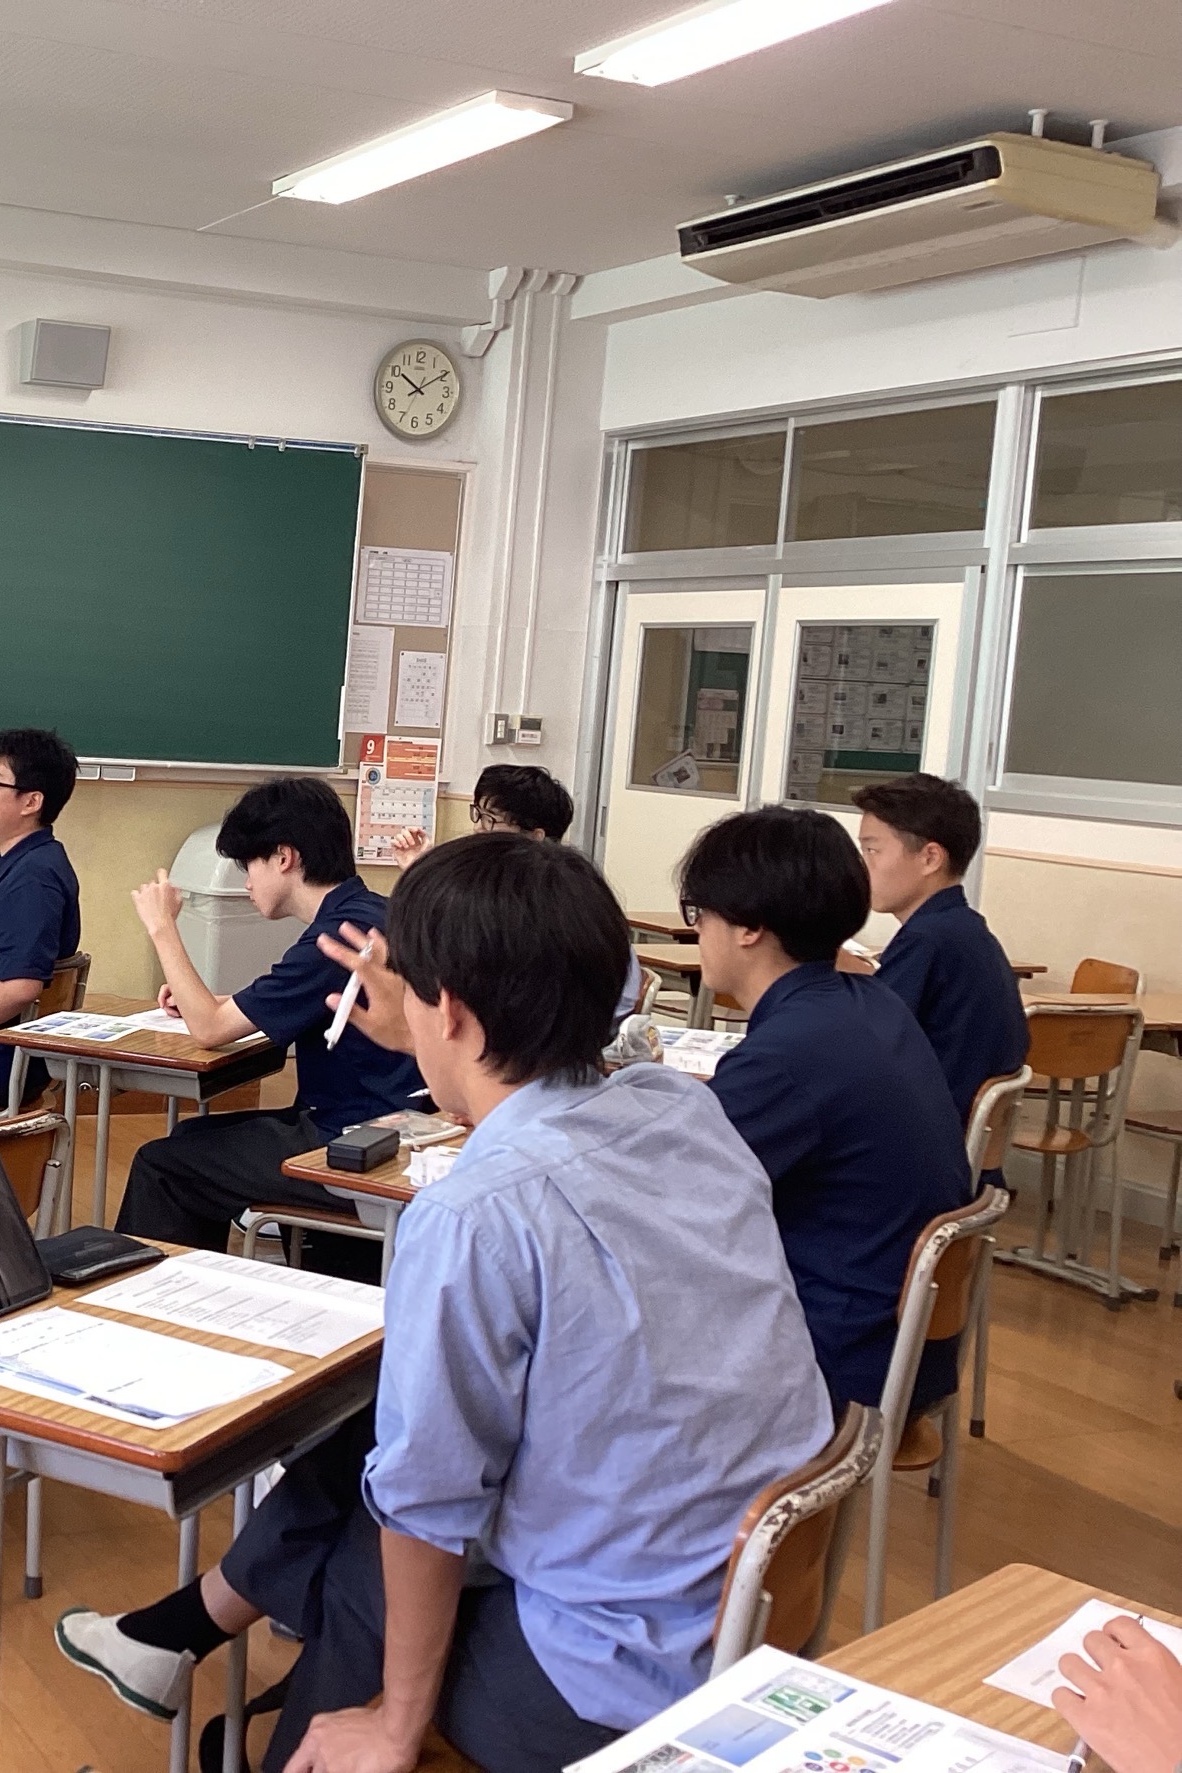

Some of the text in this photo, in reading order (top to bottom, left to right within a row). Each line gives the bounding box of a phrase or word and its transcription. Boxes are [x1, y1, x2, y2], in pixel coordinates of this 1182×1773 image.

[403, 354, 410, 365] 11
[416, 351, 426, 363] 12
[391, 365, 401, 377] 10
[440, 370, 449, 382] 2
[386, 381, 393, 393] 9
[442, 386, 449, 398] 3
[388, 398, 395, 410] 8
[437, 403, 444, 413] 4
[399, 411, 406, 422] 7
[411, 417, 418, 428] 6
[426, 414, 433, 425] 5
[366, 740, 375, 754] 9
